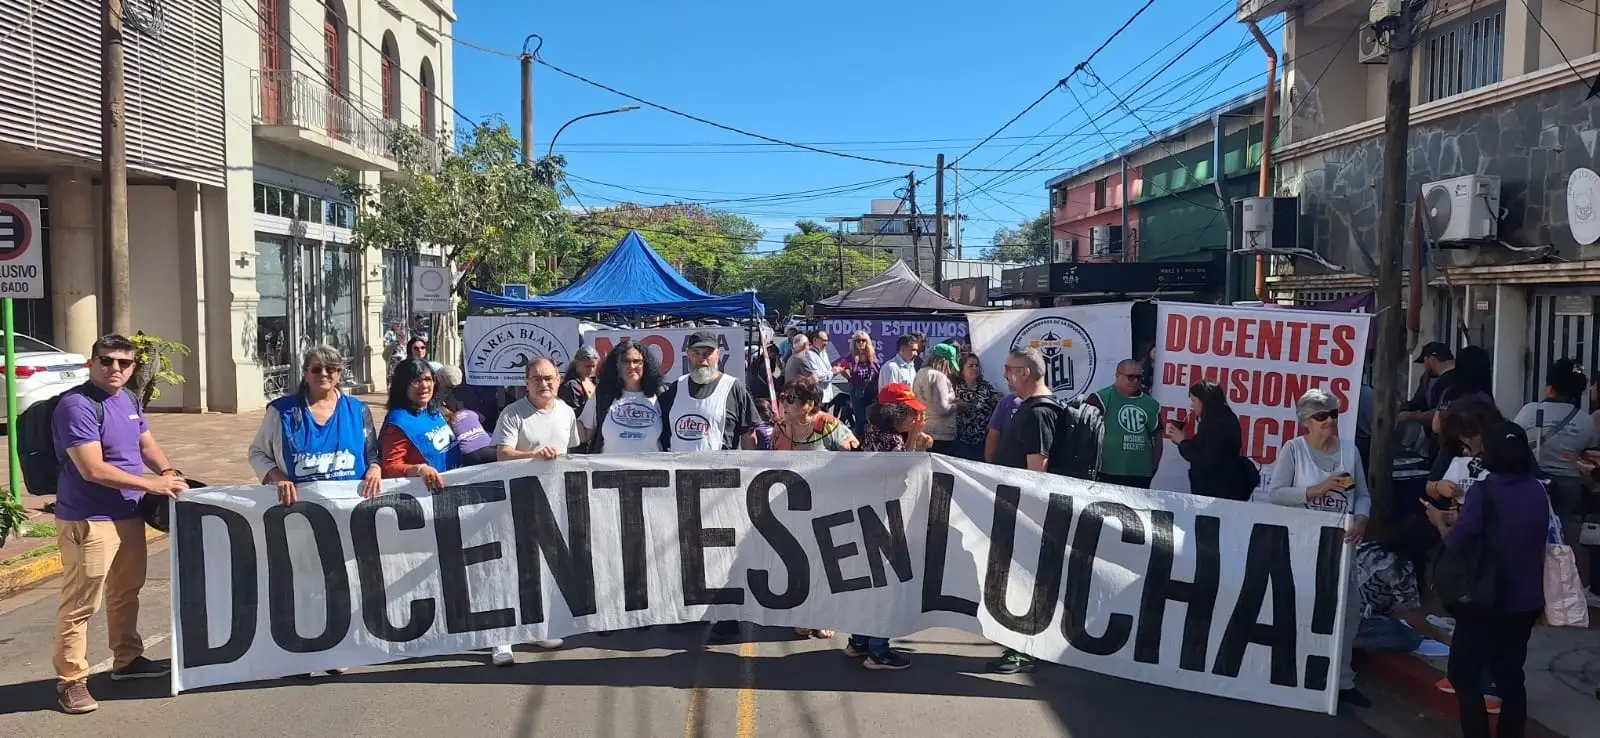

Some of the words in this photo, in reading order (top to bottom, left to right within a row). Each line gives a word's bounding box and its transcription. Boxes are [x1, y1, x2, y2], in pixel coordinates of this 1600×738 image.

[822, 319, 873, 335] TODOS
[881, 320, 969, 337] ESTUVIMOS
[1165, 313, 1356, 367] DOCENTES
[474, 330, 515, 369] MAREA
[1162, 362, 1188, 386] DE
[176, 469, 812, 668] DOCENTES
[812, 499, 914, 594] EN
[921, 471, 1345, 690] LUCHA!
